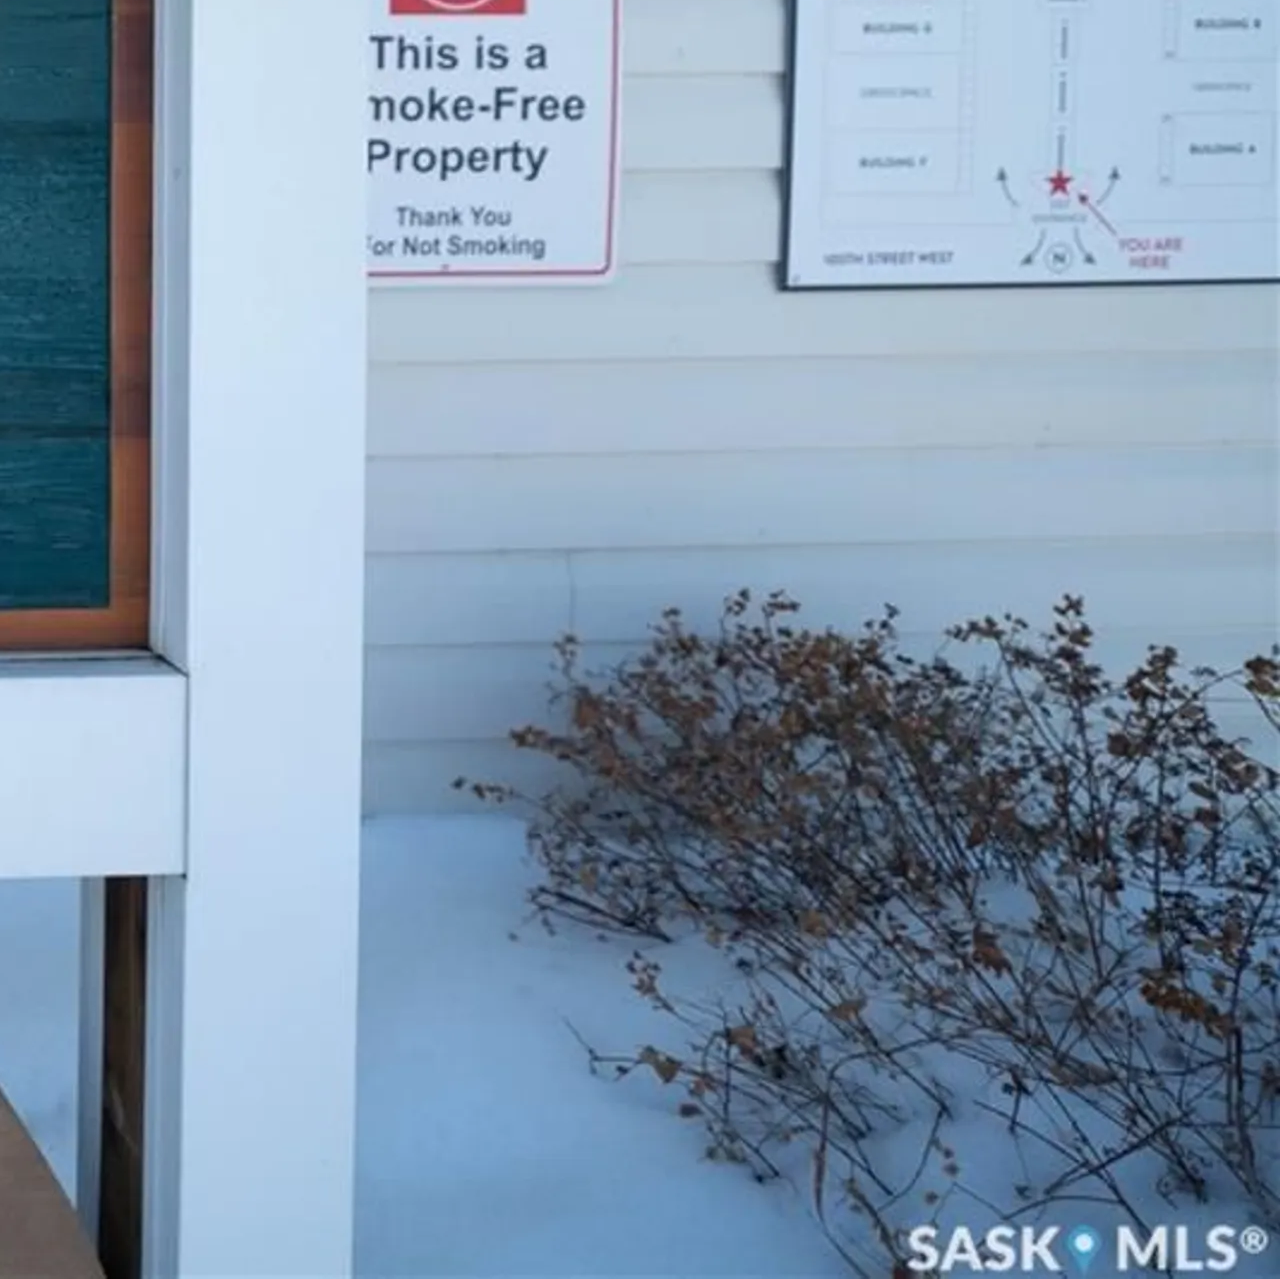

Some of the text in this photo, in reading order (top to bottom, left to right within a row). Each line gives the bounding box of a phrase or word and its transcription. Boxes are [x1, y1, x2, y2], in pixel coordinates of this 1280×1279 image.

[369, 35, 547, 70] This is a
[367, 139, 547, 181] Property
[396, 206, 512, 227] Thank You
[367, 236, 547, 260] or Not Smoking
[1119, 238, 1183, 251] YOU ARE
[867, 252, 914, 265] STREET
[918, 251, 954, 264] WEST
[1129, 255, 1170, 268] HERE
